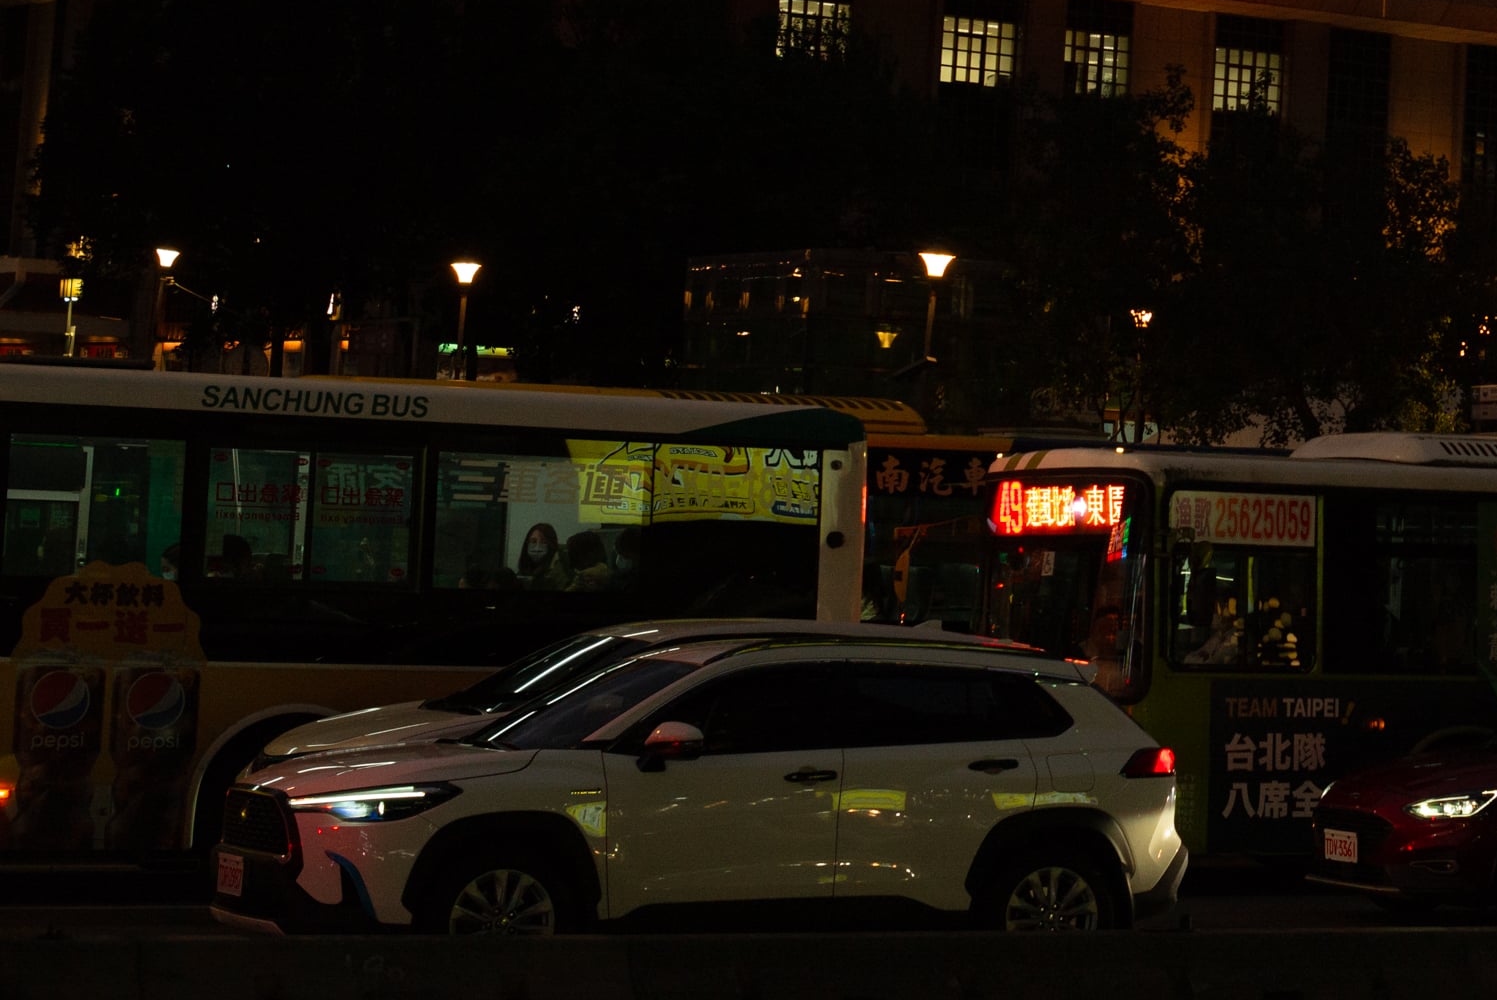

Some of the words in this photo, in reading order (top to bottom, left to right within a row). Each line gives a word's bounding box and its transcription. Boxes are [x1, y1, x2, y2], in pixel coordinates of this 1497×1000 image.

[202, 385, 364, 415] SANCHUNG
[371, 394, 429, 418] BUS
[452, 459, 628, 505] 三重客運
[1000, 481, 1023, 534] 49
[1215, 498, 1310, 539] 25625059
[65, 581, 163, 606] 大杯飲料
[40, 608, 184, 644] 買一送一
[1225, 697, 1278, 718] TEAM
[31, 732, 84, 751] pepsi
[127, 734, 180, 752] pepsi
[1224, 732, 1326, 772] 台北隊
[1221, 780, 1323, 819] 八席全
